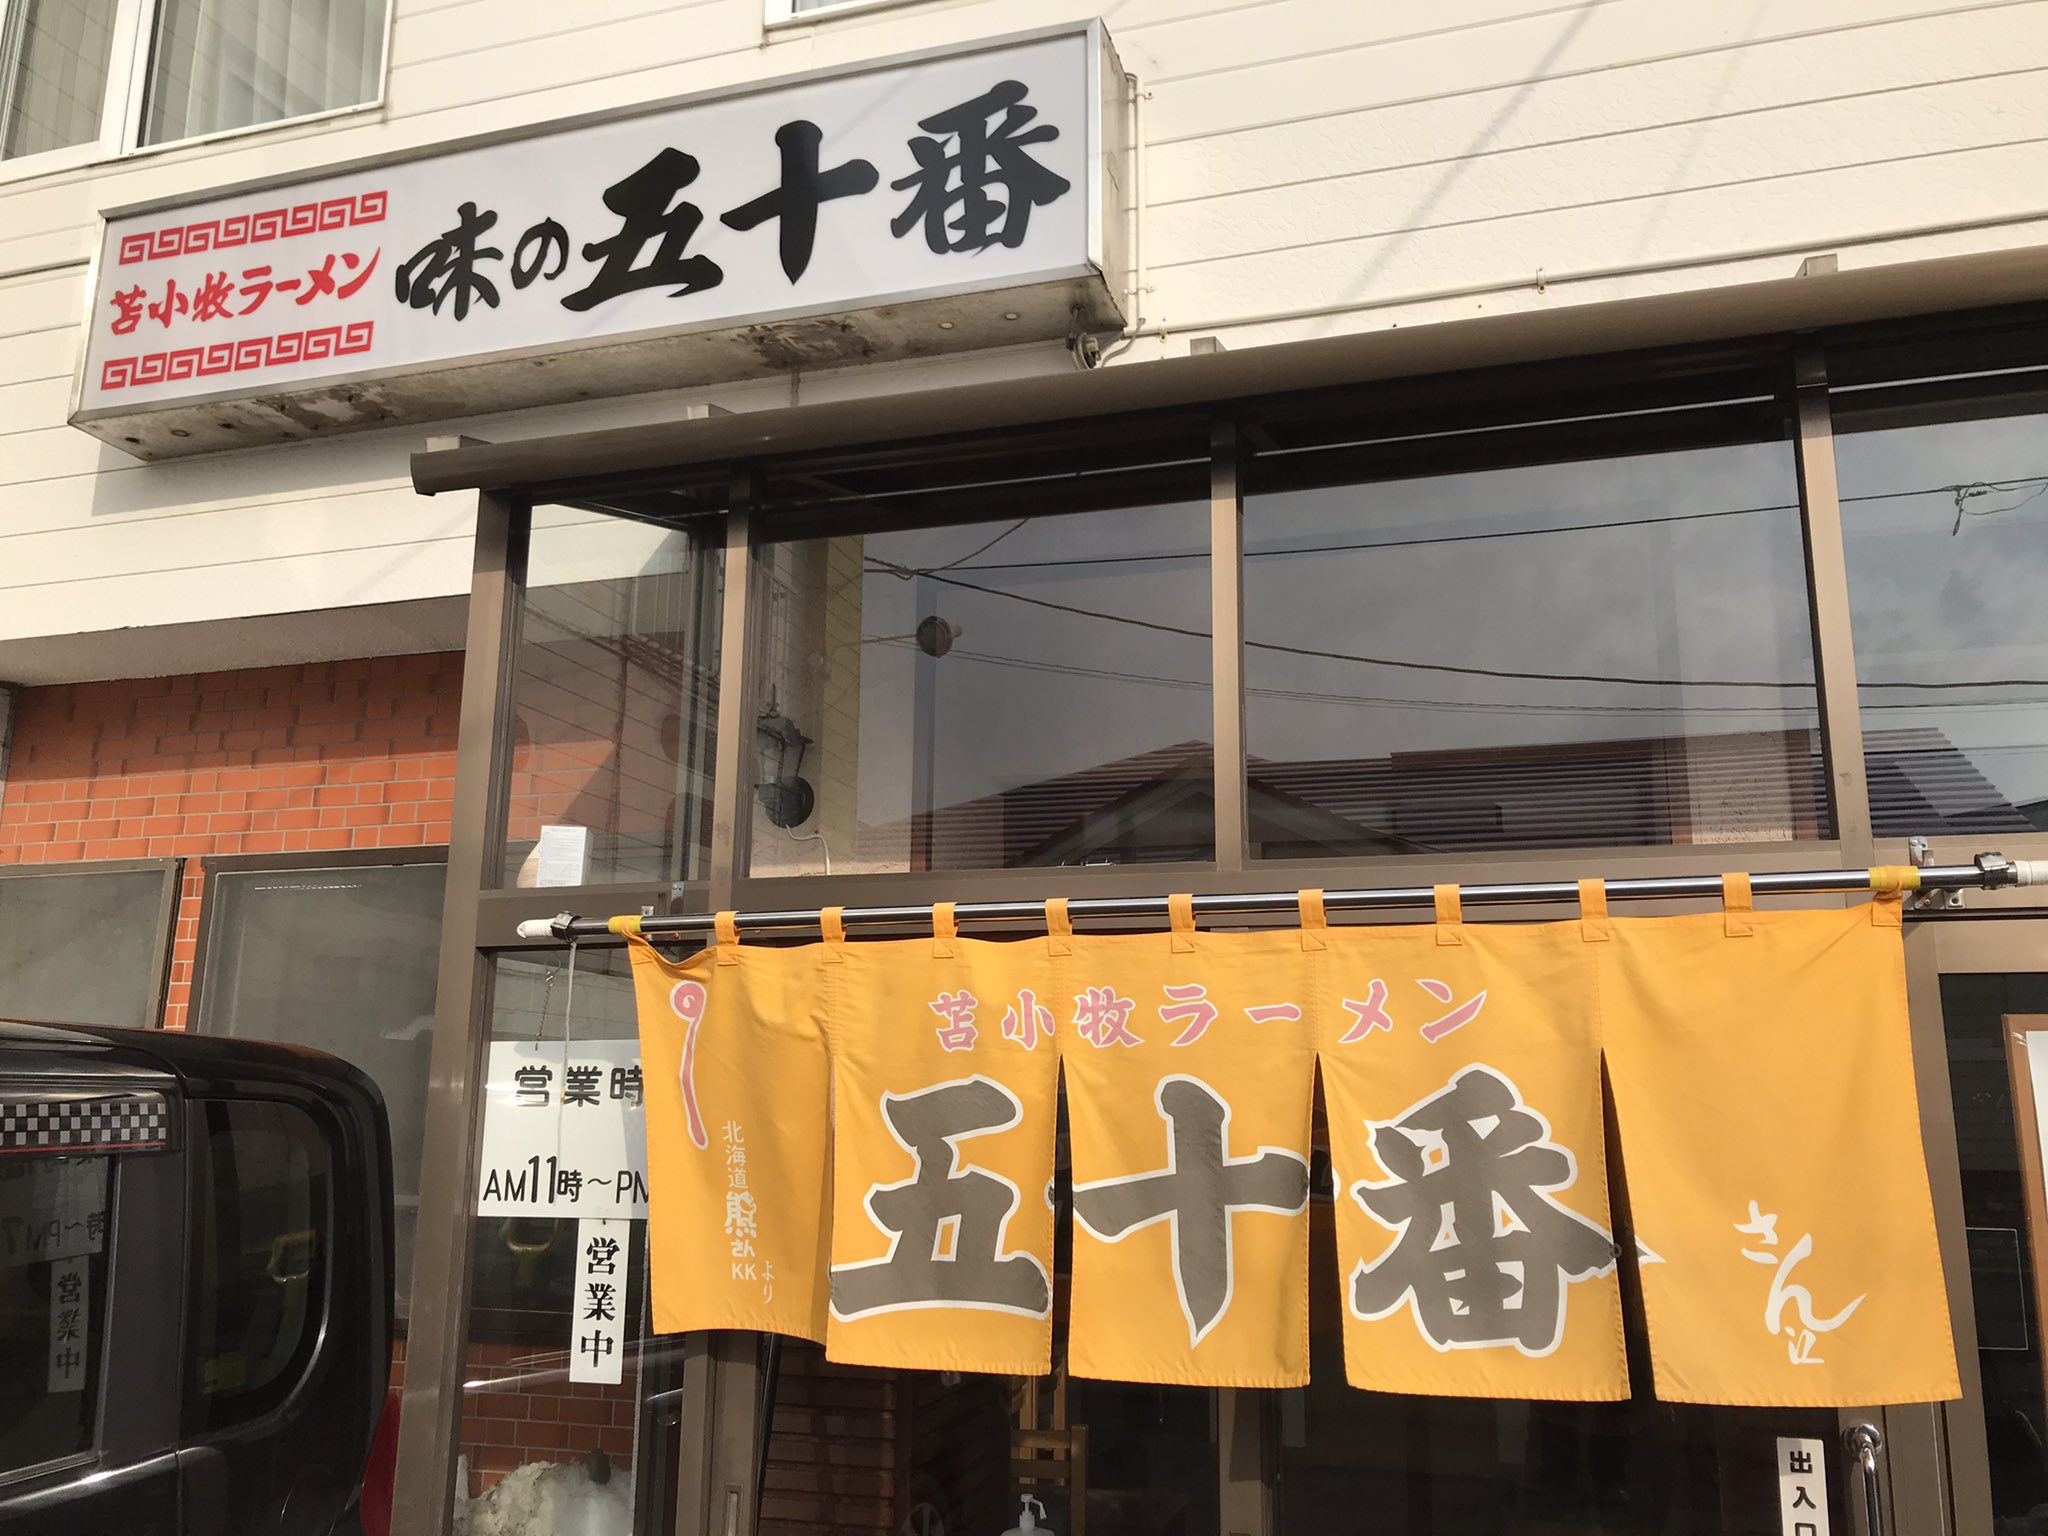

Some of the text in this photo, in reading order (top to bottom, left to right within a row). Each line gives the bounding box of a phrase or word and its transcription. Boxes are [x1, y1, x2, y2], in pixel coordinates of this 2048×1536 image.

[395, 80, 1071, 321] 味の五十番
[109, 246, 382, 336] 苫小牧ラーメン
[928, 977, 1488, 1052] 苫小牧ラーメン
[828, 1062, 1666, 1357] 五十番
[580, 1236, 621, 1368] 営業中
